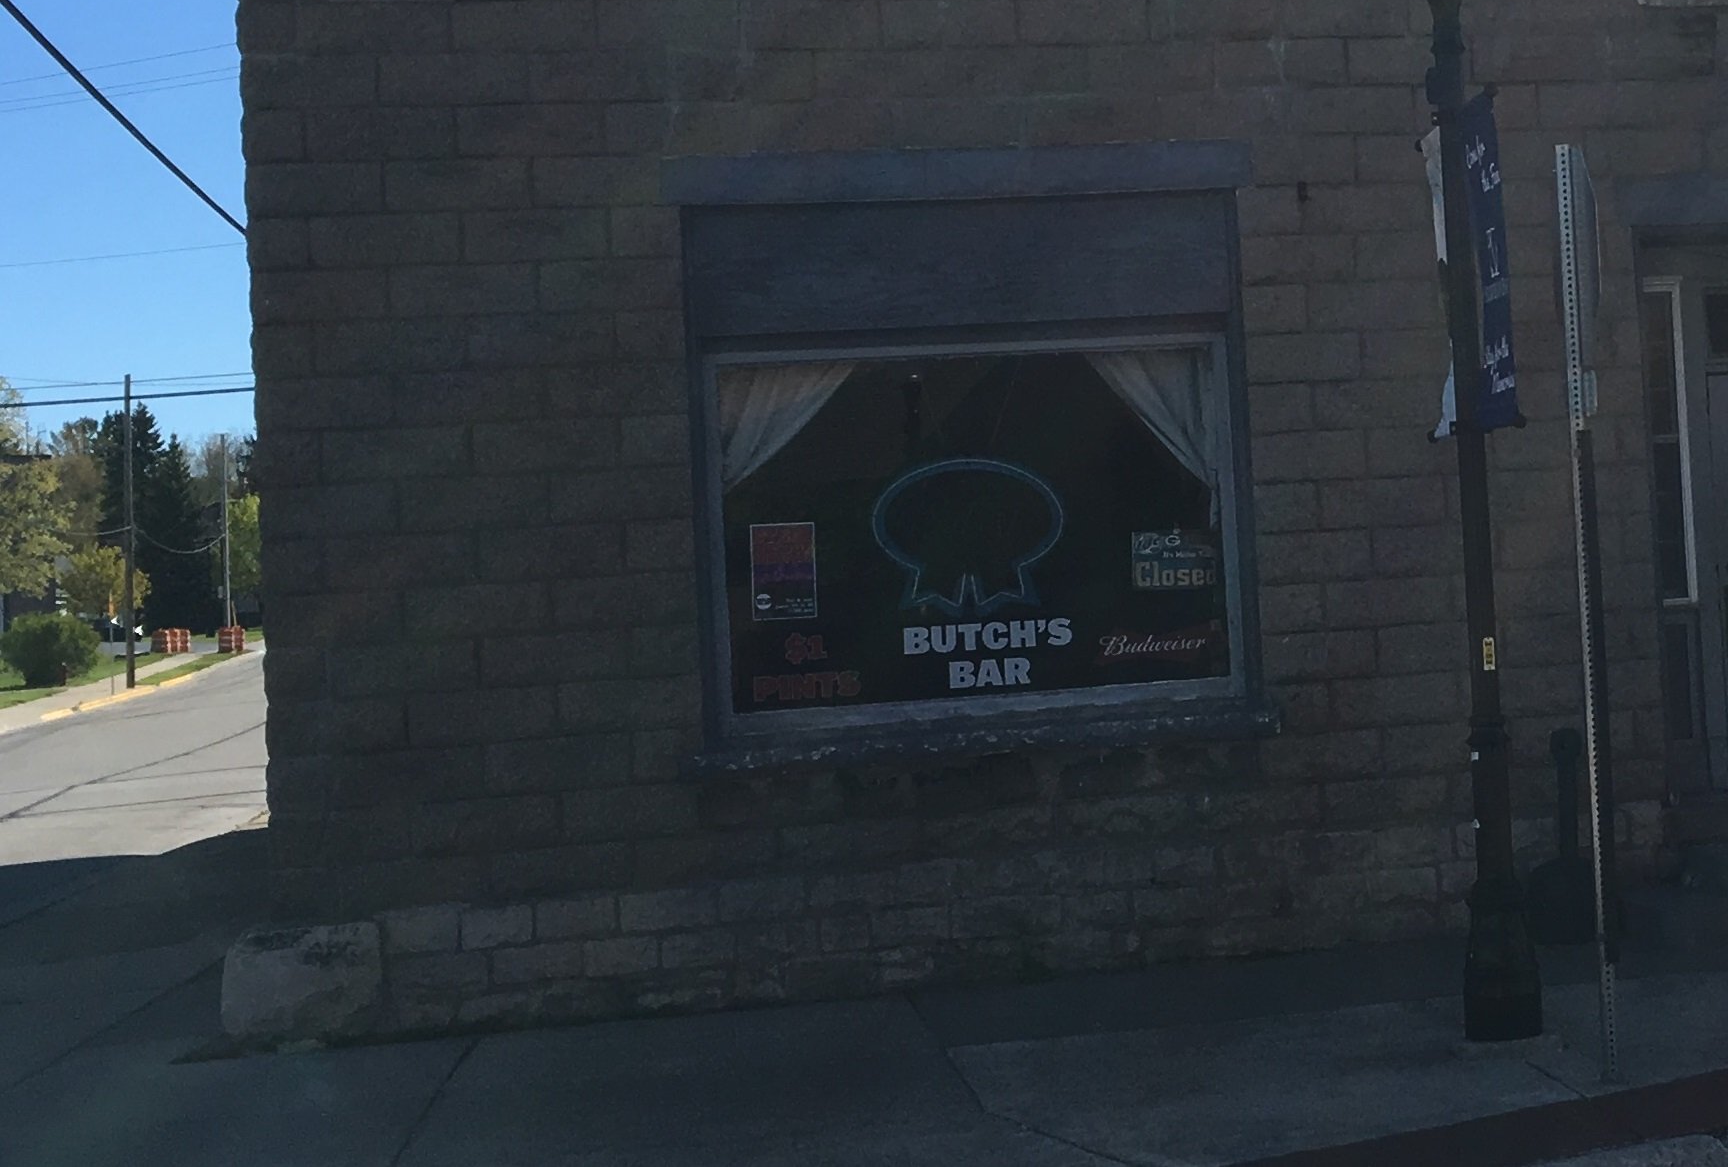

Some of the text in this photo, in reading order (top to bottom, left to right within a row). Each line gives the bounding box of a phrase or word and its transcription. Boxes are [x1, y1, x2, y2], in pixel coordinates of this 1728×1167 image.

[1135, 560, 1216, 587] Closed
[784, 633, 828, 665] $1
[903, 618, 1072, 654] BUTCH'S
[1099, 634, 1206, 656] Budweiser
[753, 670, 861, 702] PINTS
[949, 657, 1031, 689] BAR
